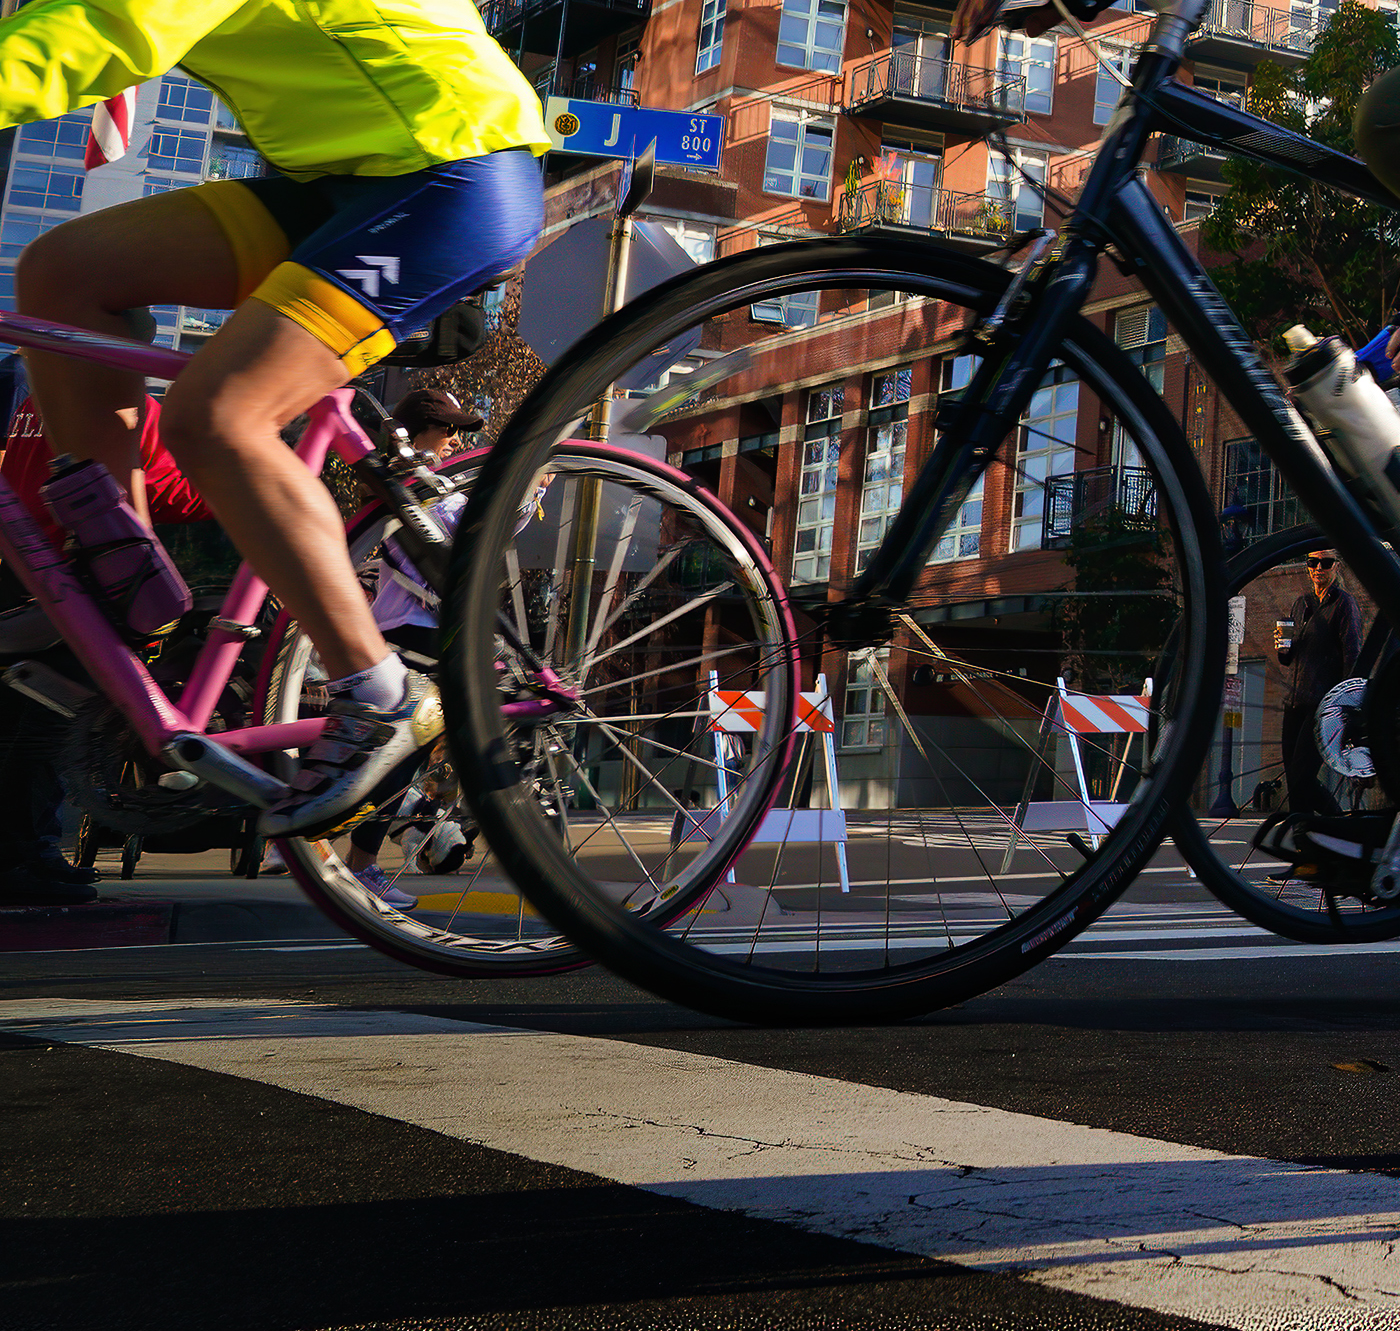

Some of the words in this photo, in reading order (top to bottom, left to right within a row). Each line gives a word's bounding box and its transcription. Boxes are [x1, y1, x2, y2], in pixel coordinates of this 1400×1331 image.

[604, 113, 621, 147] J
[690, 118, 708, 133] ST
[681, 135, 711, 152] 800
